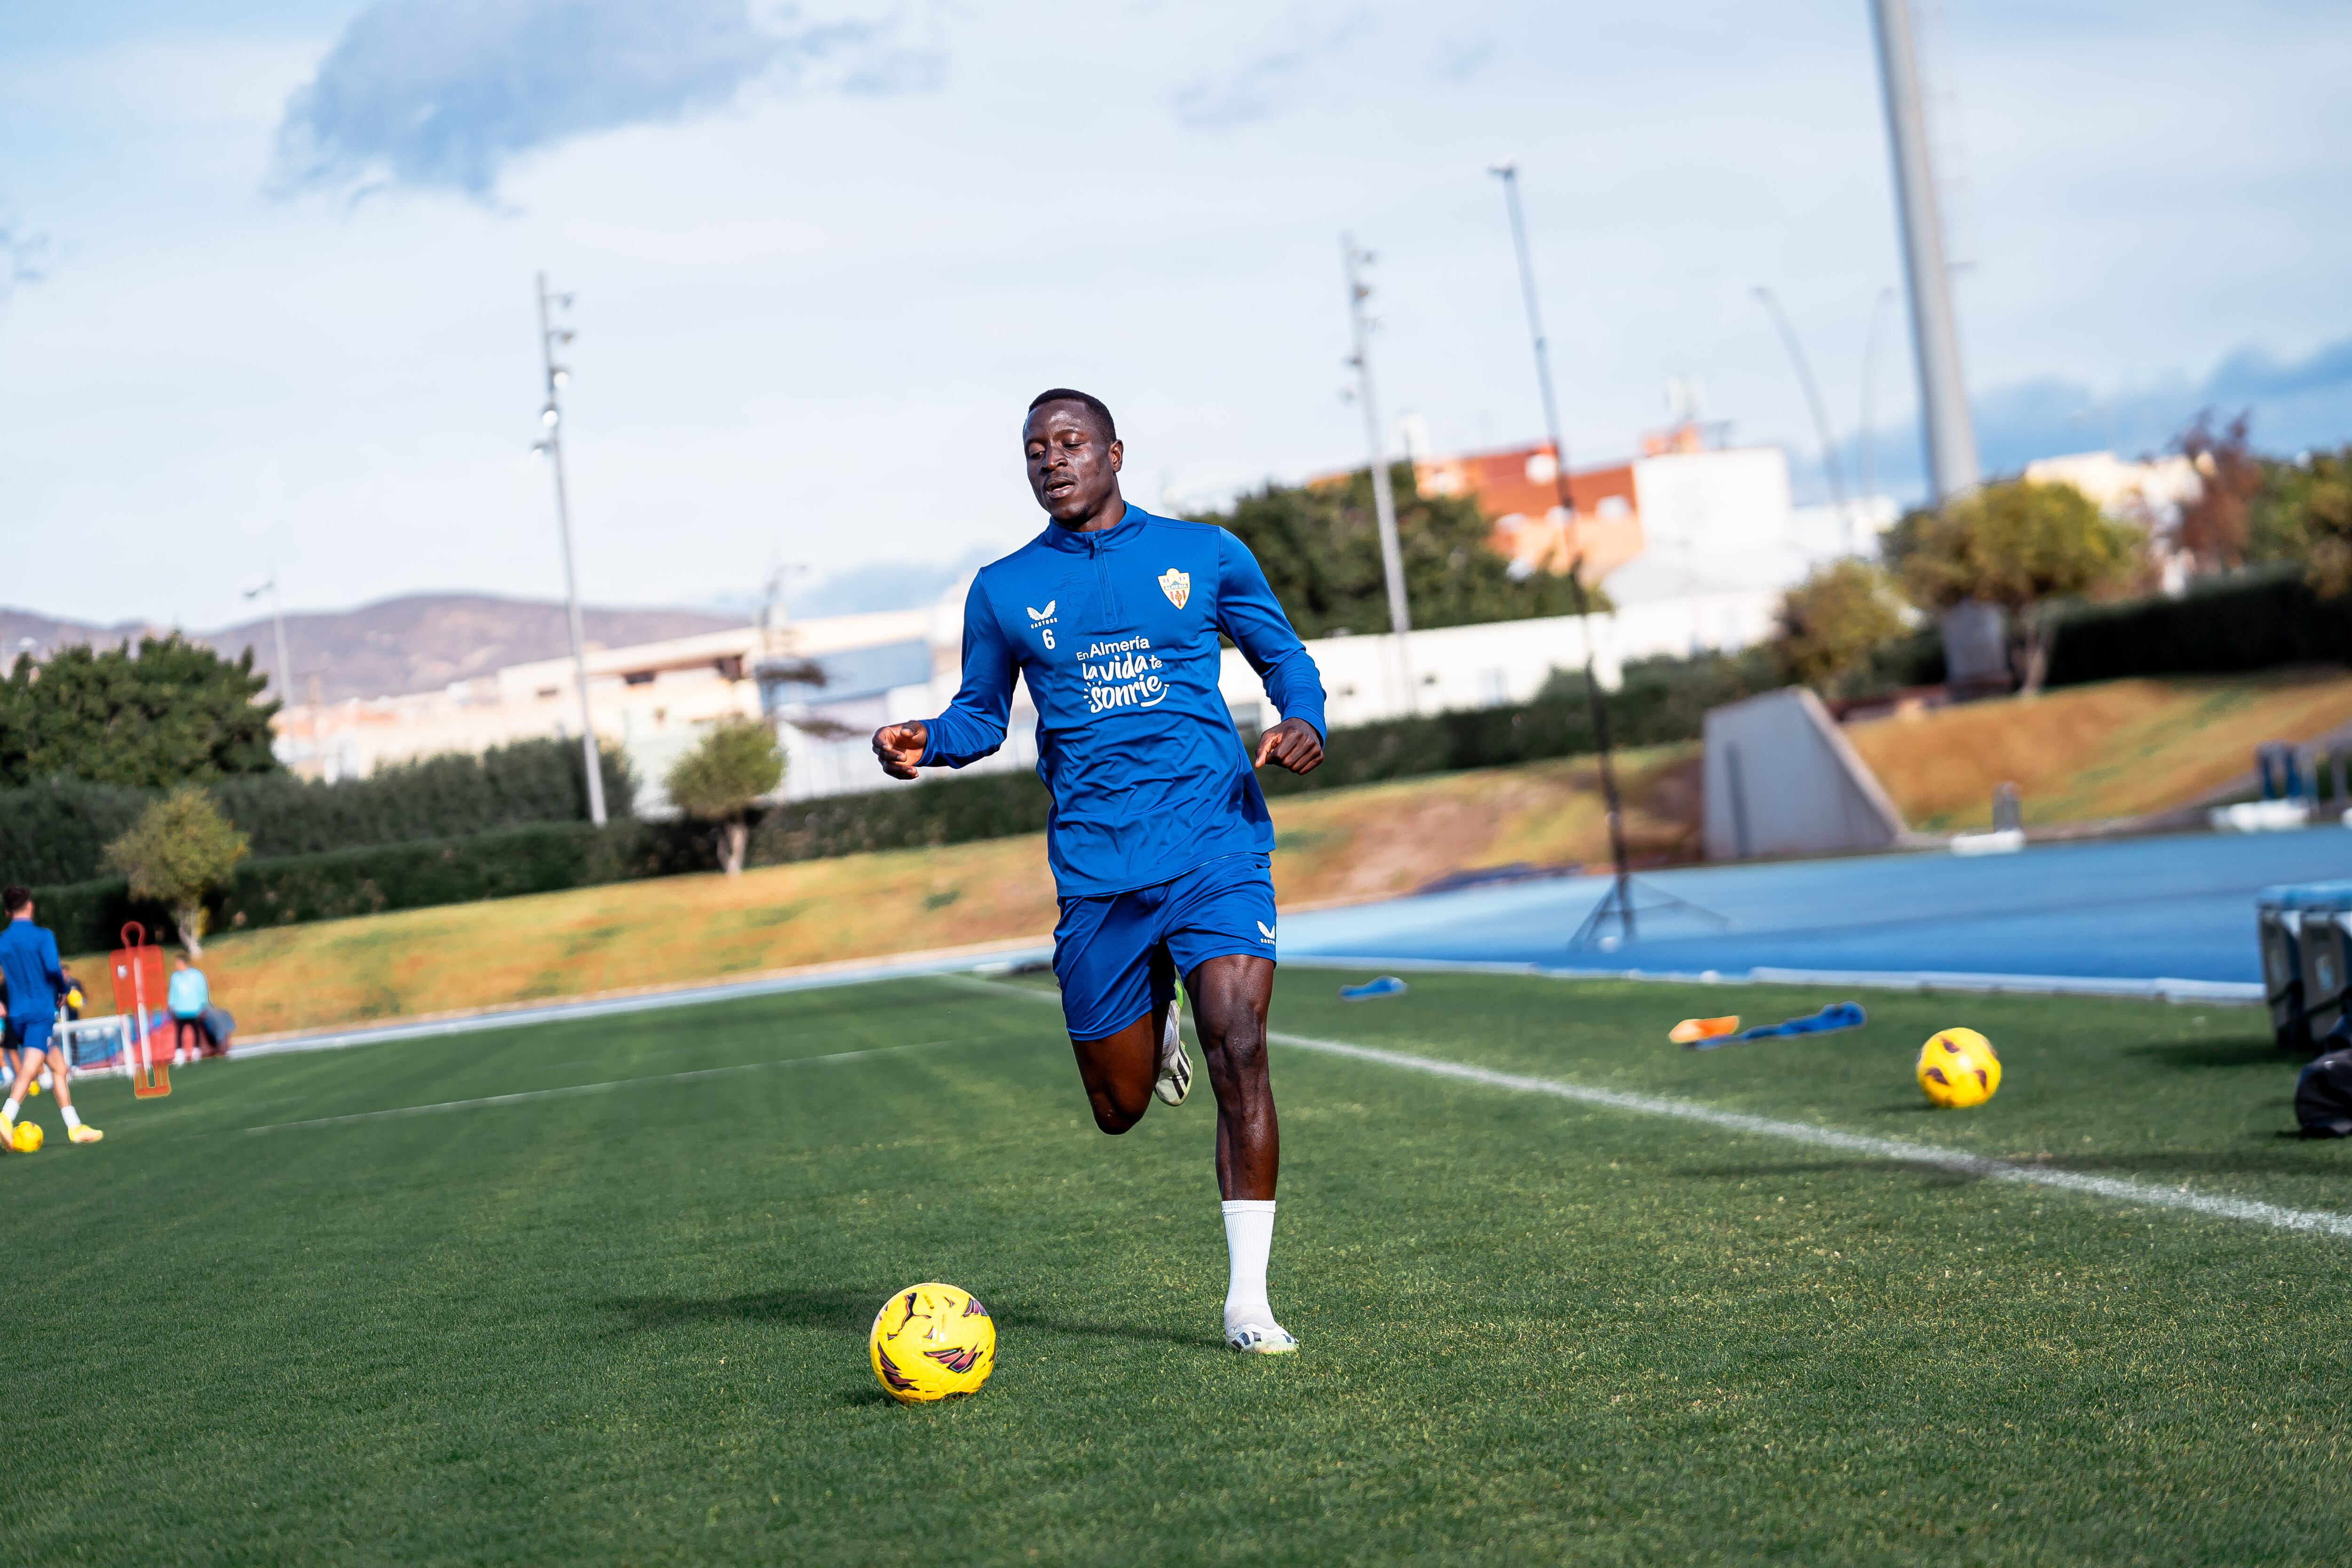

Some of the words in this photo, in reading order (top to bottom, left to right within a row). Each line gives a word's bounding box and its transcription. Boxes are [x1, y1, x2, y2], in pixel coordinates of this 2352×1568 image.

[1031, 617, 1058, 629] CASTORE
[1042, 629, 1056, 650] 6
[1076, 651, 1089, 661] En
[1090, 636, 1150, 658] Almería
[1082, 663, 1098, 680] la
[1099, 652, 1149, 681] vida
[1149, 654, 1162, 669] te
